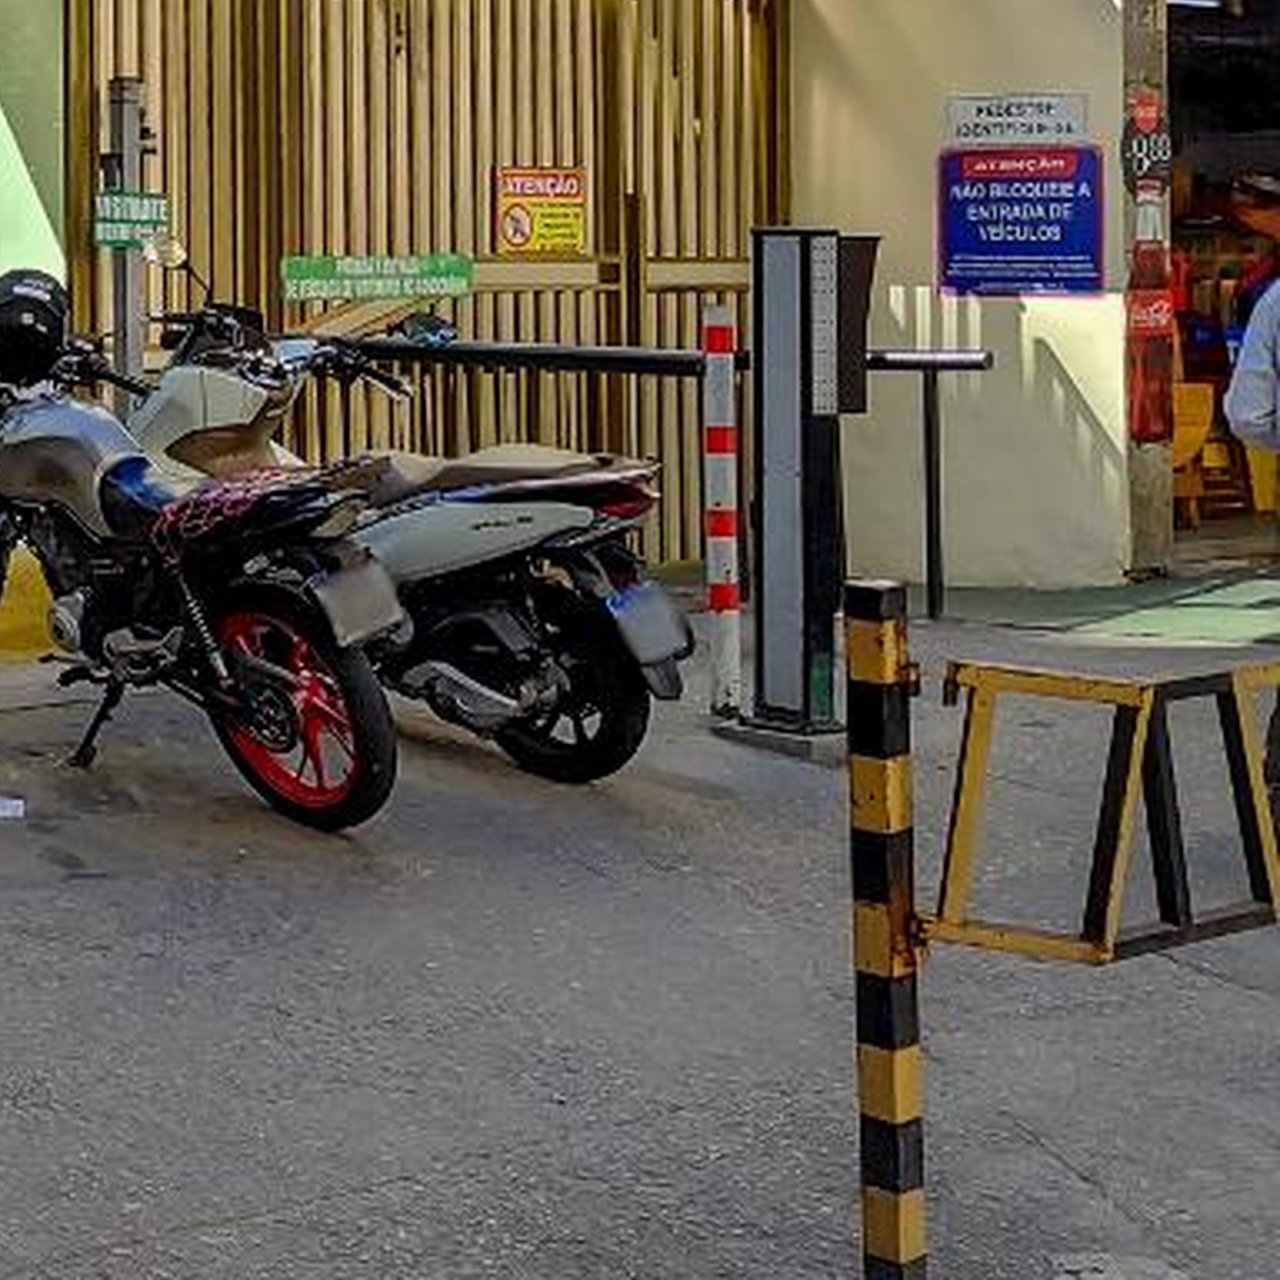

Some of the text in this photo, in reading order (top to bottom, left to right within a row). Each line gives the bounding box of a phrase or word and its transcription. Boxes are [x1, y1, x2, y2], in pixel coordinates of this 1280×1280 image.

[973, 158, 1067, 174] ATENÇÃO
[502, 174, 579, 199] ATENÇÃO
[950, 178, 986, 200] NÃO
[1078, 182, 1092, 198] A
[966, 203, 1074, 222] ENTRADA DE
[977, 222, 1062, 242] VEÍCULOS
